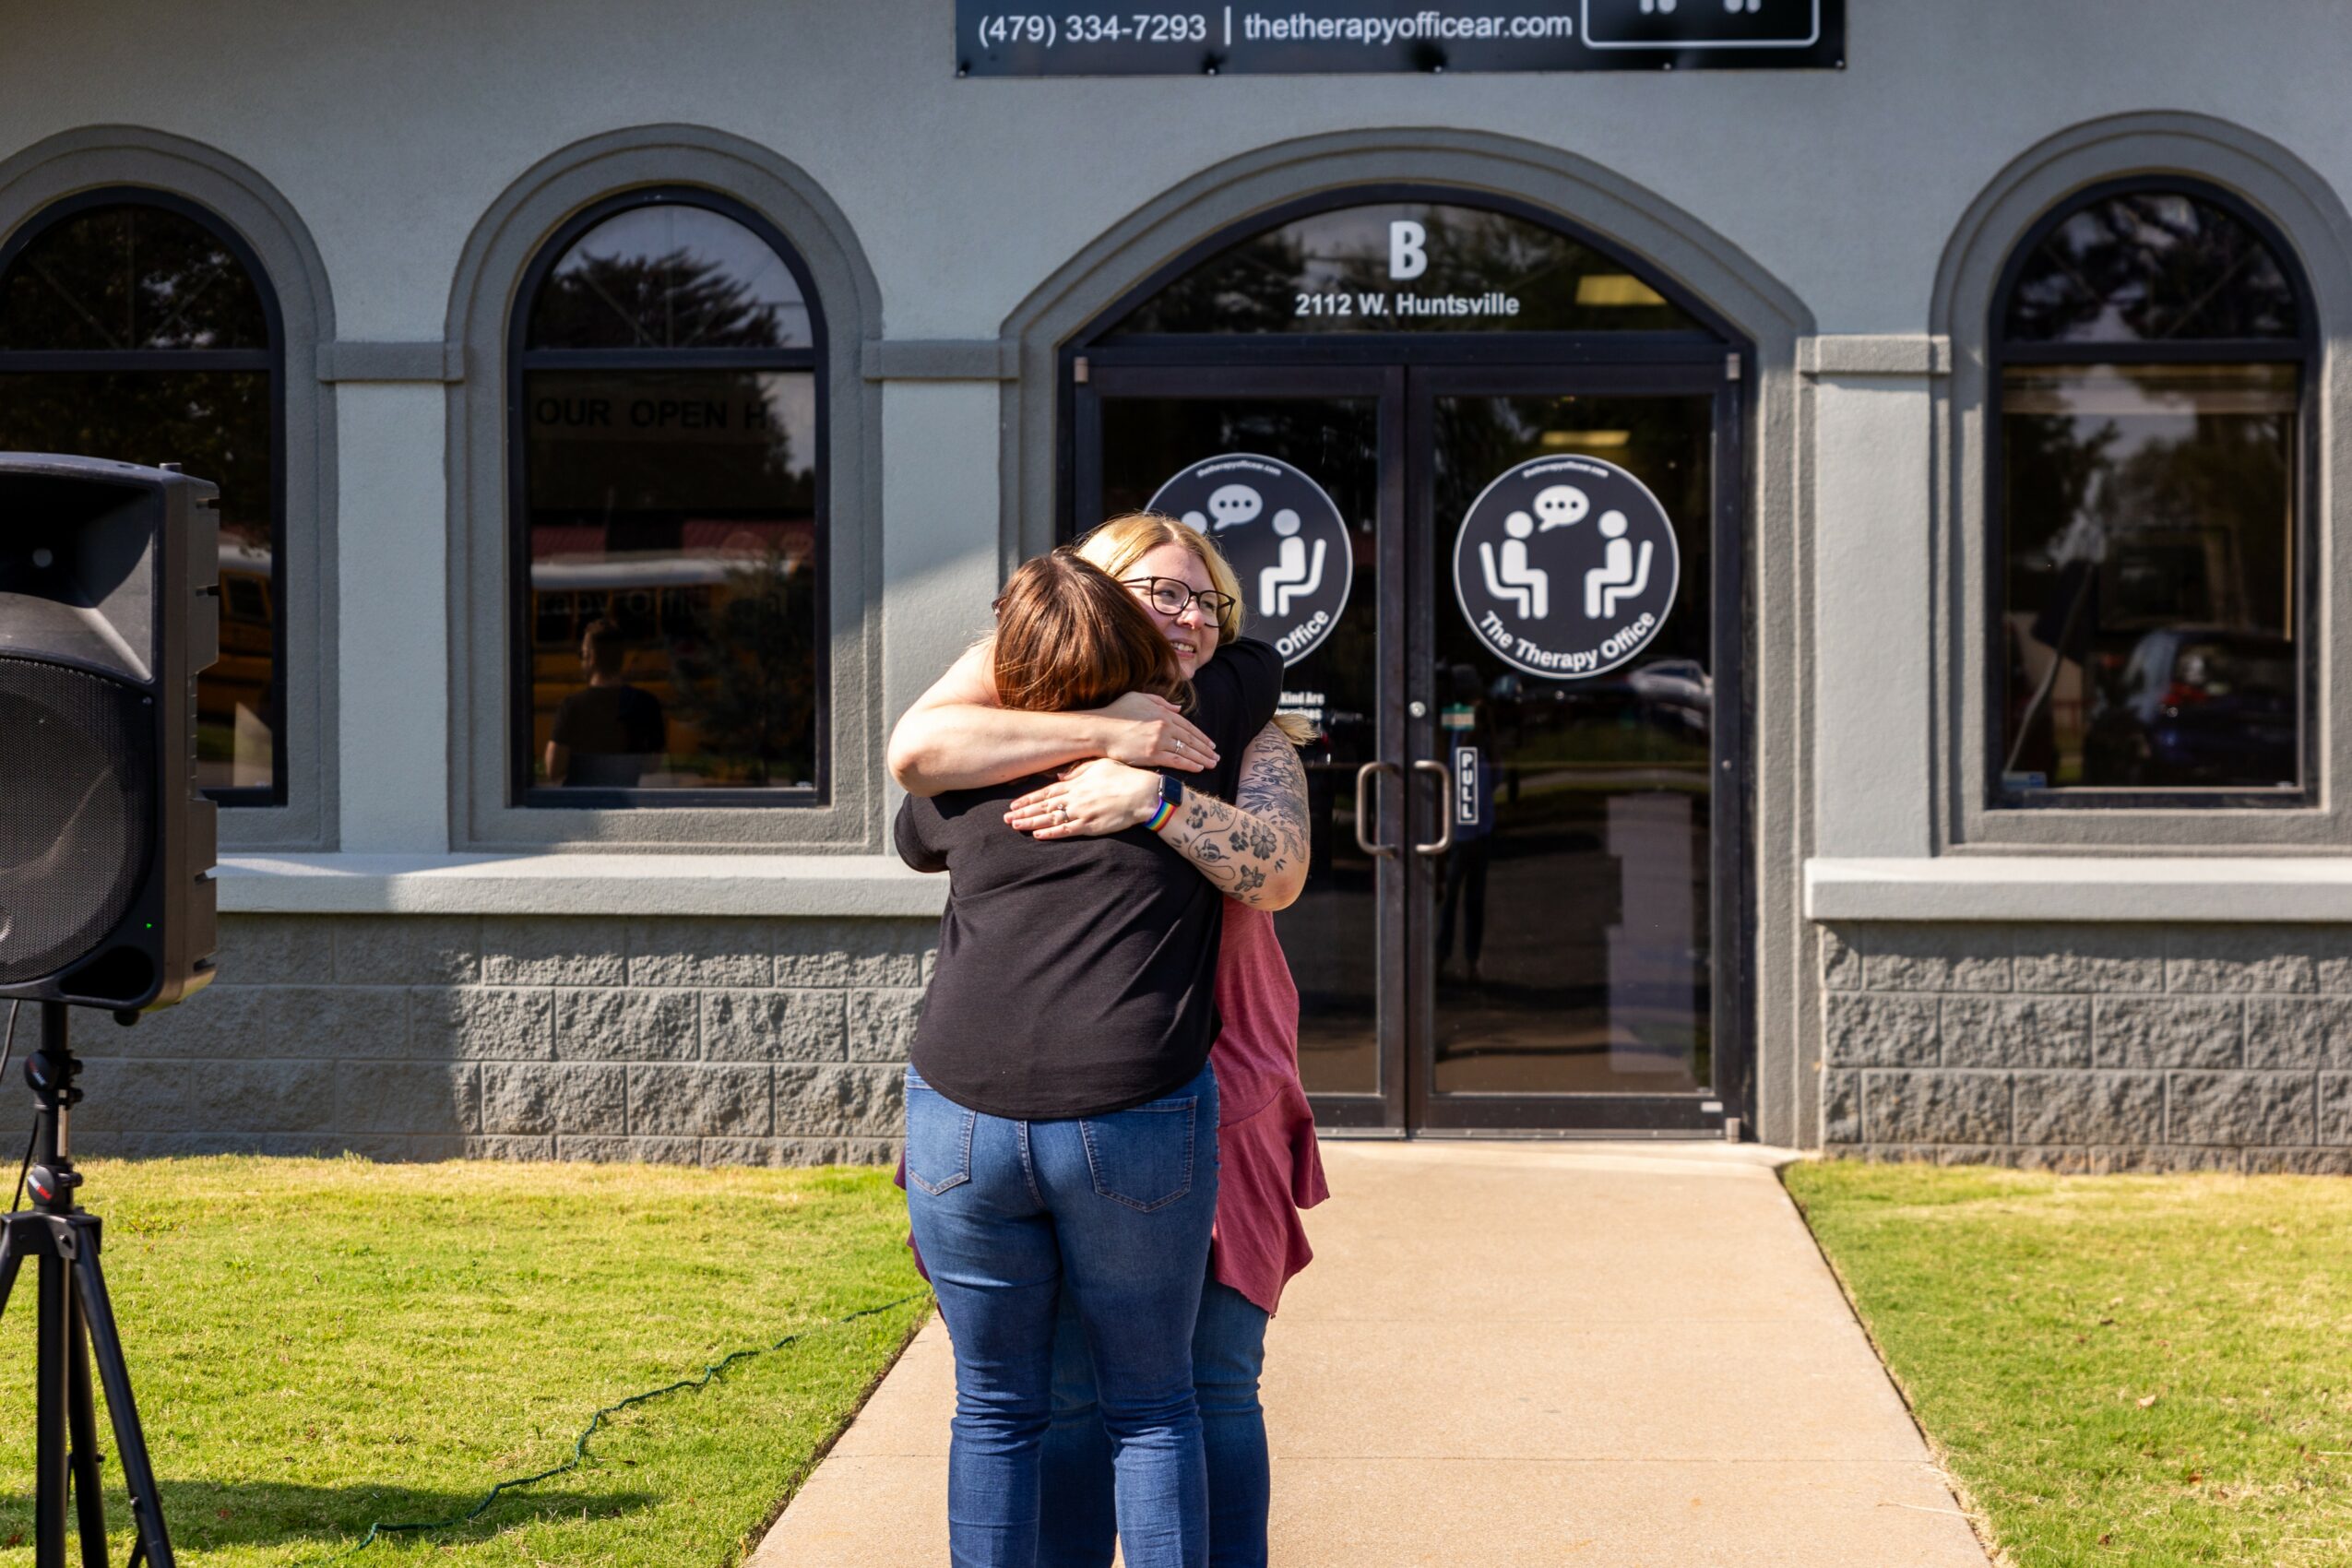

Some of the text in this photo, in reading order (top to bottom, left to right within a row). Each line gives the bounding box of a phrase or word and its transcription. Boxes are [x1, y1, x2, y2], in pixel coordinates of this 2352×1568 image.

[979, 11, 1572, 47] (479) 334-7293 thetherapyofficear.com
[1390, 220, 1428, 280] B
[1295, 292, 1520, 315] 2112 W. Huntsville
[536, 397, 612, 426] OUR
[630, 398, 727, 429] OPEN
[1276, 610, 1329, 656] Office
[1479, 610, 1656, 671] The Therapy Office
[1461, 753, 1474, 819] PULL
